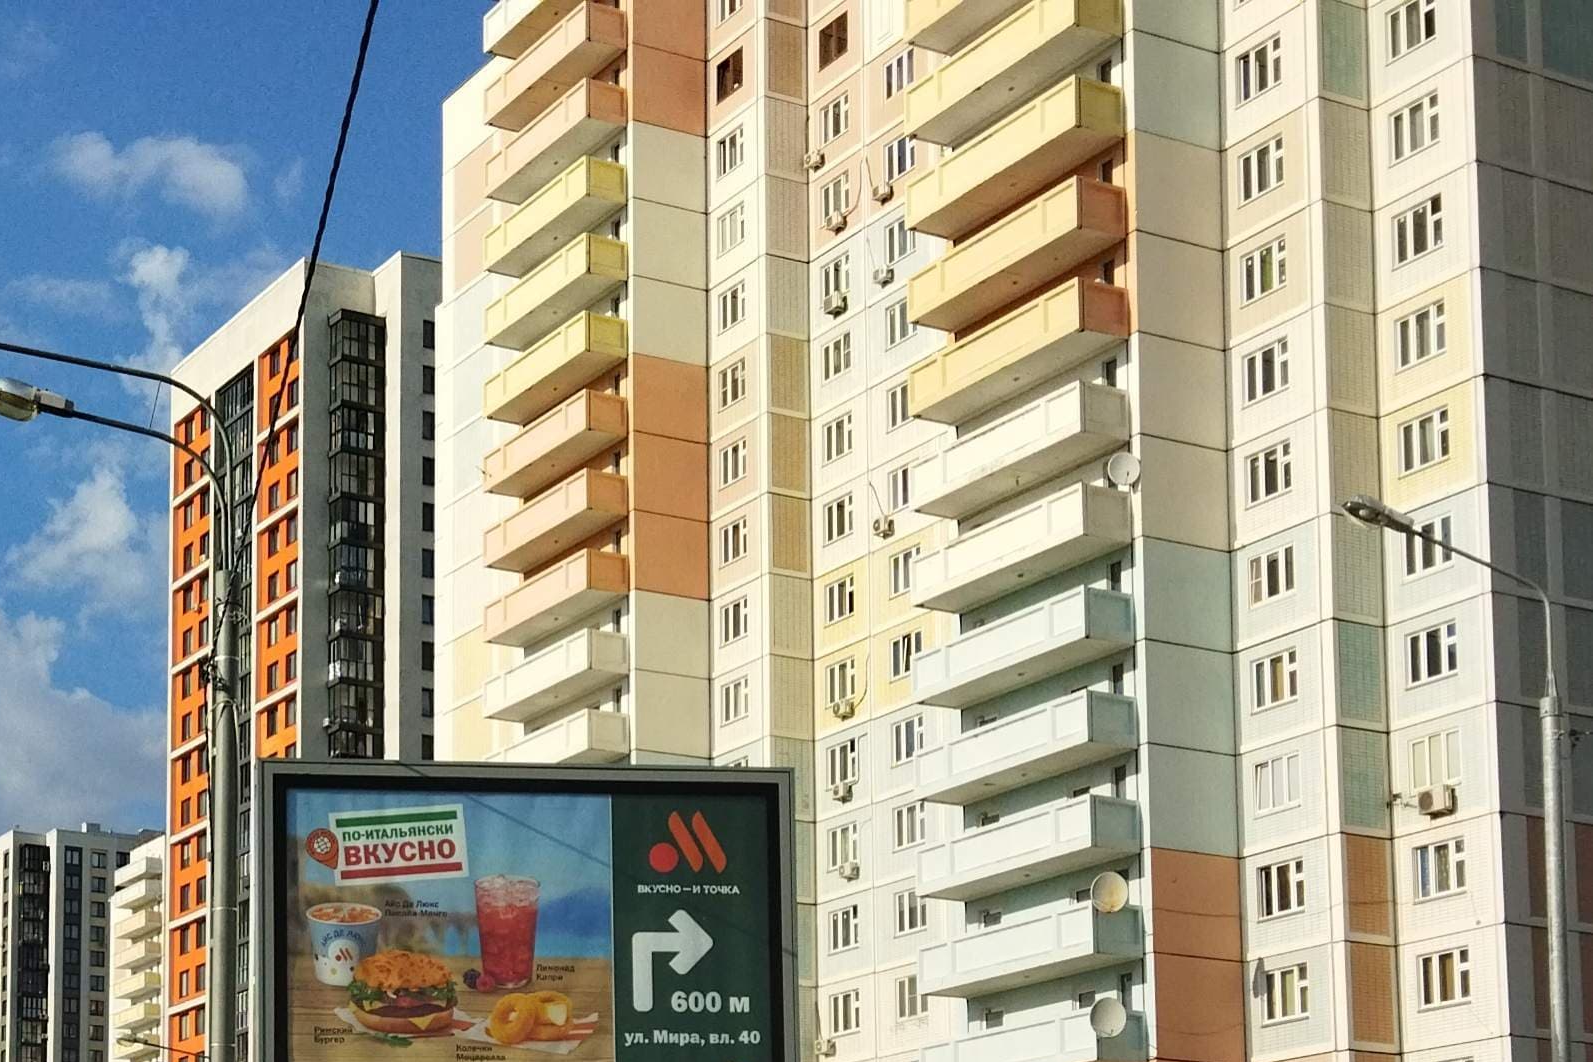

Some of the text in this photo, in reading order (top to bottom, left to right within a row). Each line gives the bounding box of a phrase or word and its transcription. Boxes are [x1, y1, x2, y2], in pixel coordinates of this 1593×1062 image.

[342, 823, 454, 842] ПО-ИТАЛЬЯНСКИ
[343, 838, 457, 867] ВКУСНО
[637, 884, 682, 894] ВКУСНО
[704, 885, 741, 895] ТОЧКА
[670, 990, 750, 1013] 600 м
[624, 1029, 761, 1047] ул. Мира, вл. 40
